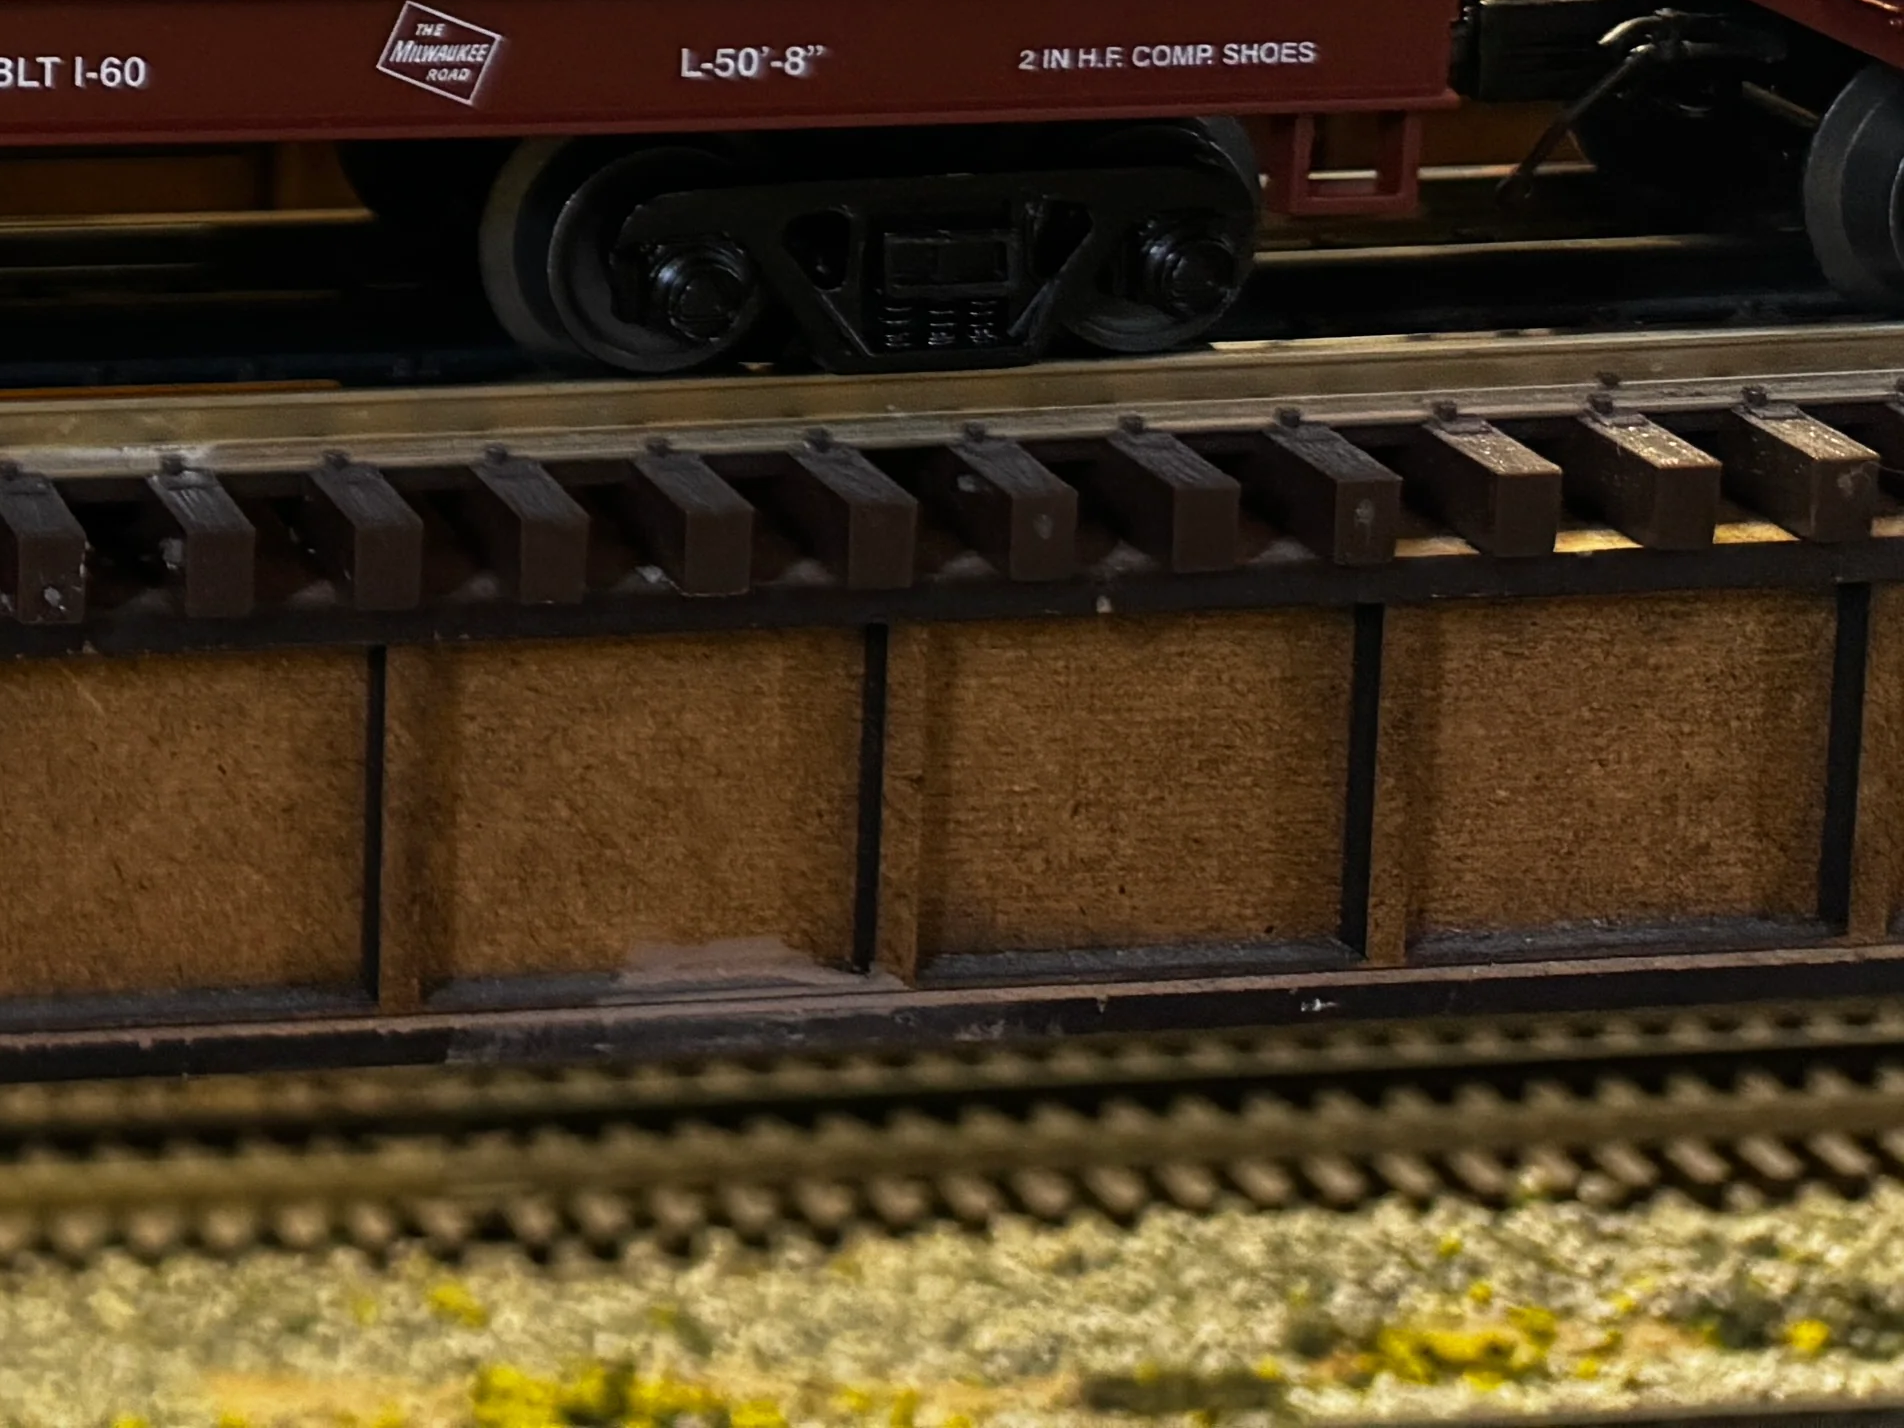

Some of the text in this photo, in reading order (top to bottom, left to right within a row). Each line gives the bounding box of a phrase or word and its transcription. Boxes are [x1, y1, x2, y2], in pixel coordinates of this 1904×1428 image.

[415, 23, 447, 37] THE
[1018, 48, 1037, 71] 2
[1042, 47, 1071, 70] IN
[1131, 43, 1214, 68] COMP.
[1221, 41, 1316, 66] SHOES
[426, 67, 471, 82] ROAD
